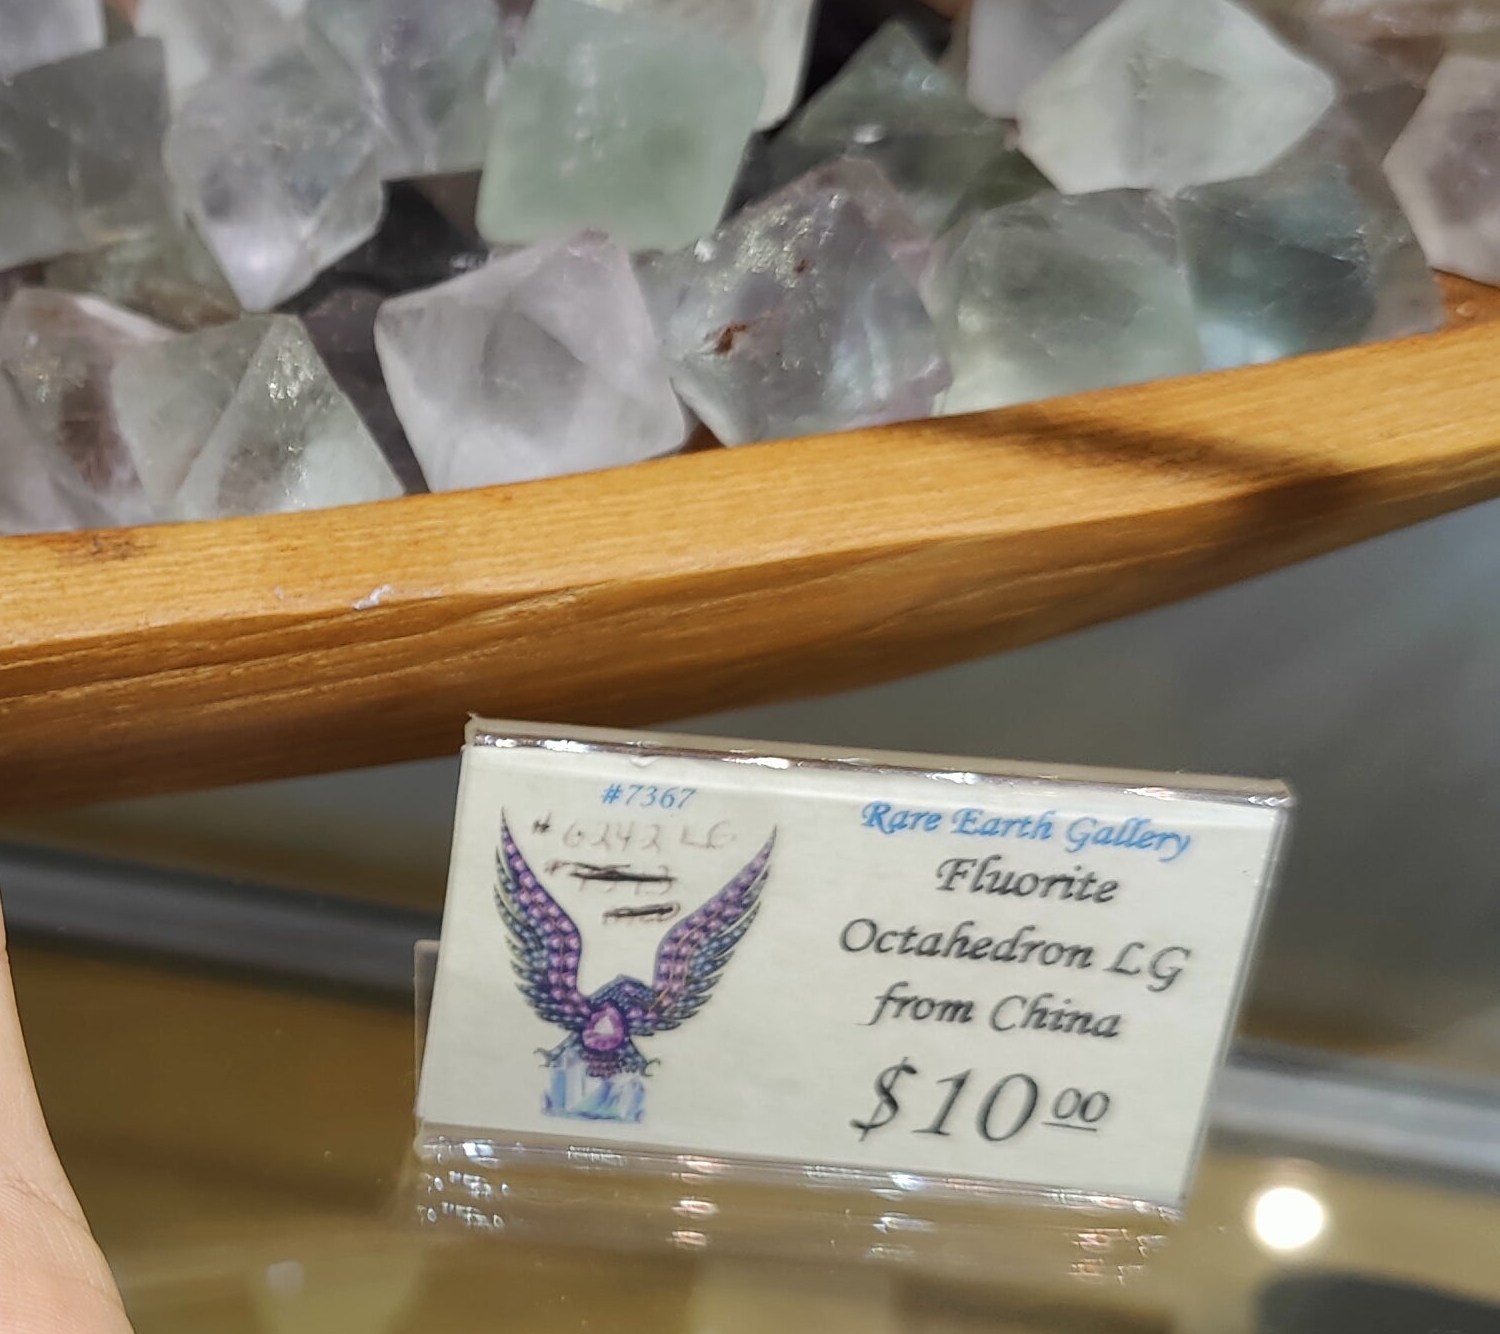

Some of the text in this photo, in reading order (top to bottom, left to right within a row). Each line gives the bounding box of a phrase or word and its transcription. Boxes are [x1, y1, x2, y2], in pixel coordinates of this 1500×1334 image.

[601, 783, 697, 810] #7367
[861, 800, 1192, 863] Rare Earth Gallery
[935, 854, 1120, 904] Fluorite
[838, 917, 1193, 993] Octahedron LG
[856, 980, 1124, 1039] from China
